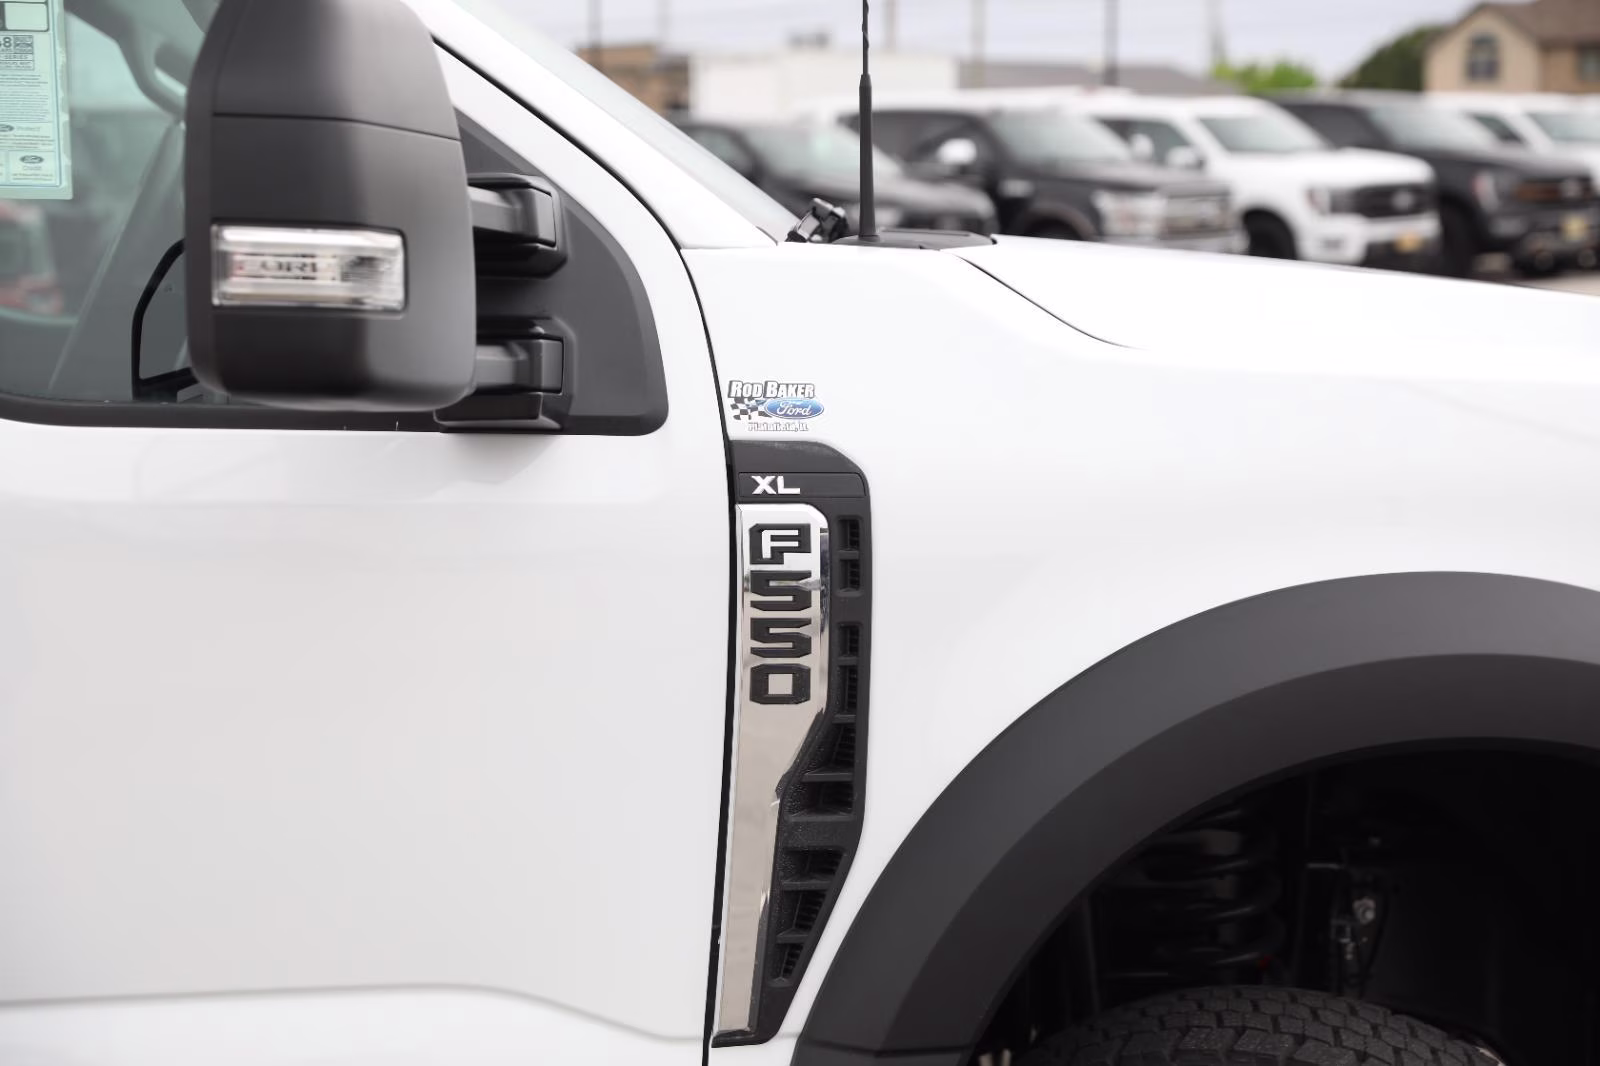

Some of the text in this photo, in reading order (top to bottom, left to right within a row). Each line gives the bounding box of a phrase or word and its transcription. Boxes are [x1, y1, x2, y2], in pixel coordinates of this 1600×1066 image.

[0, 36, 12, 48] 8
[728, 380, 814, 398] ROD BAKER
[751, 475, 801, 495] XL
[749, 523, 812, 705] F550
